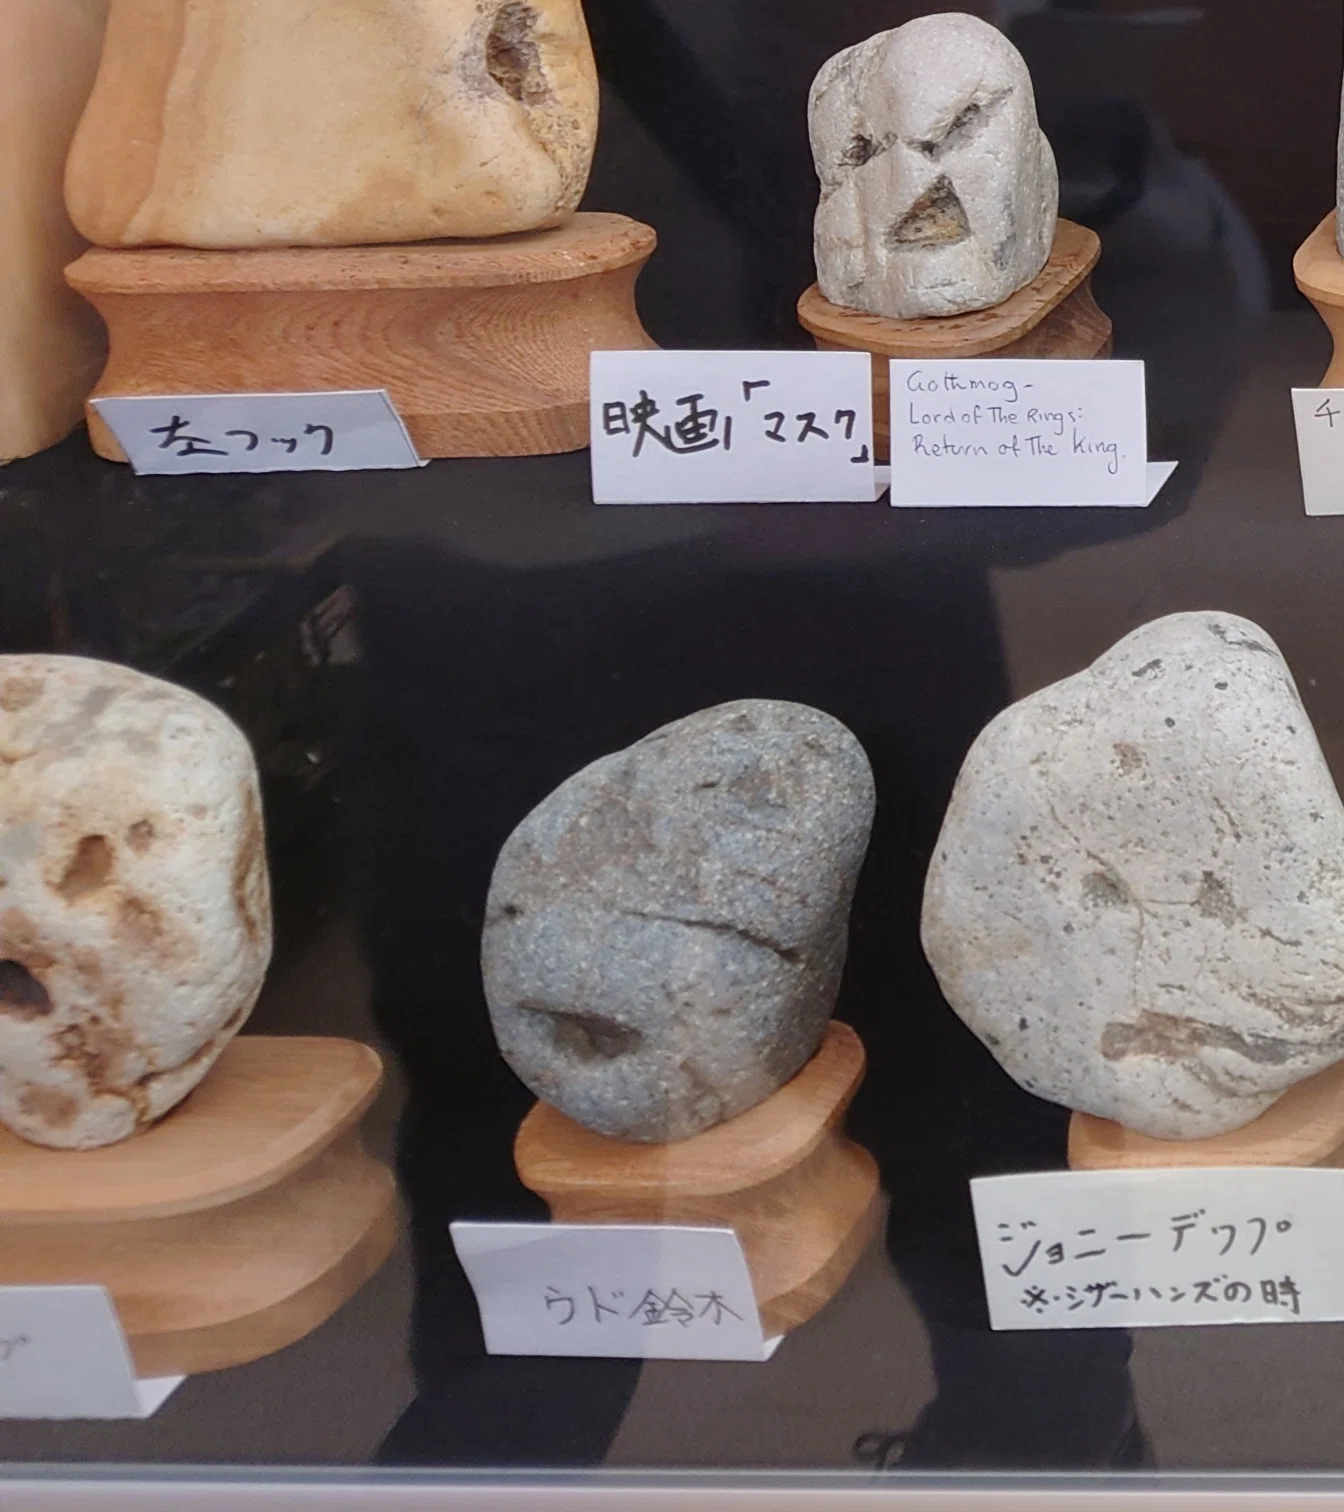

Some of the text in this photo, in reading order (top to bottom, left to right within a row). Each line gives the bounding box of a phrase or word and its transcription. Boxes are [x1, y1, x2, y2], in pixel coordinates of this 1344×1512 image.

[910, 402, 955, 425] Lord
[961, 404, 981, 424] of
[988, 406, 1017, 424] The
[914, 434, 988, 458] Return
[999, 434, 1020, 456] of
[1024, 436, 1058, 456] The
